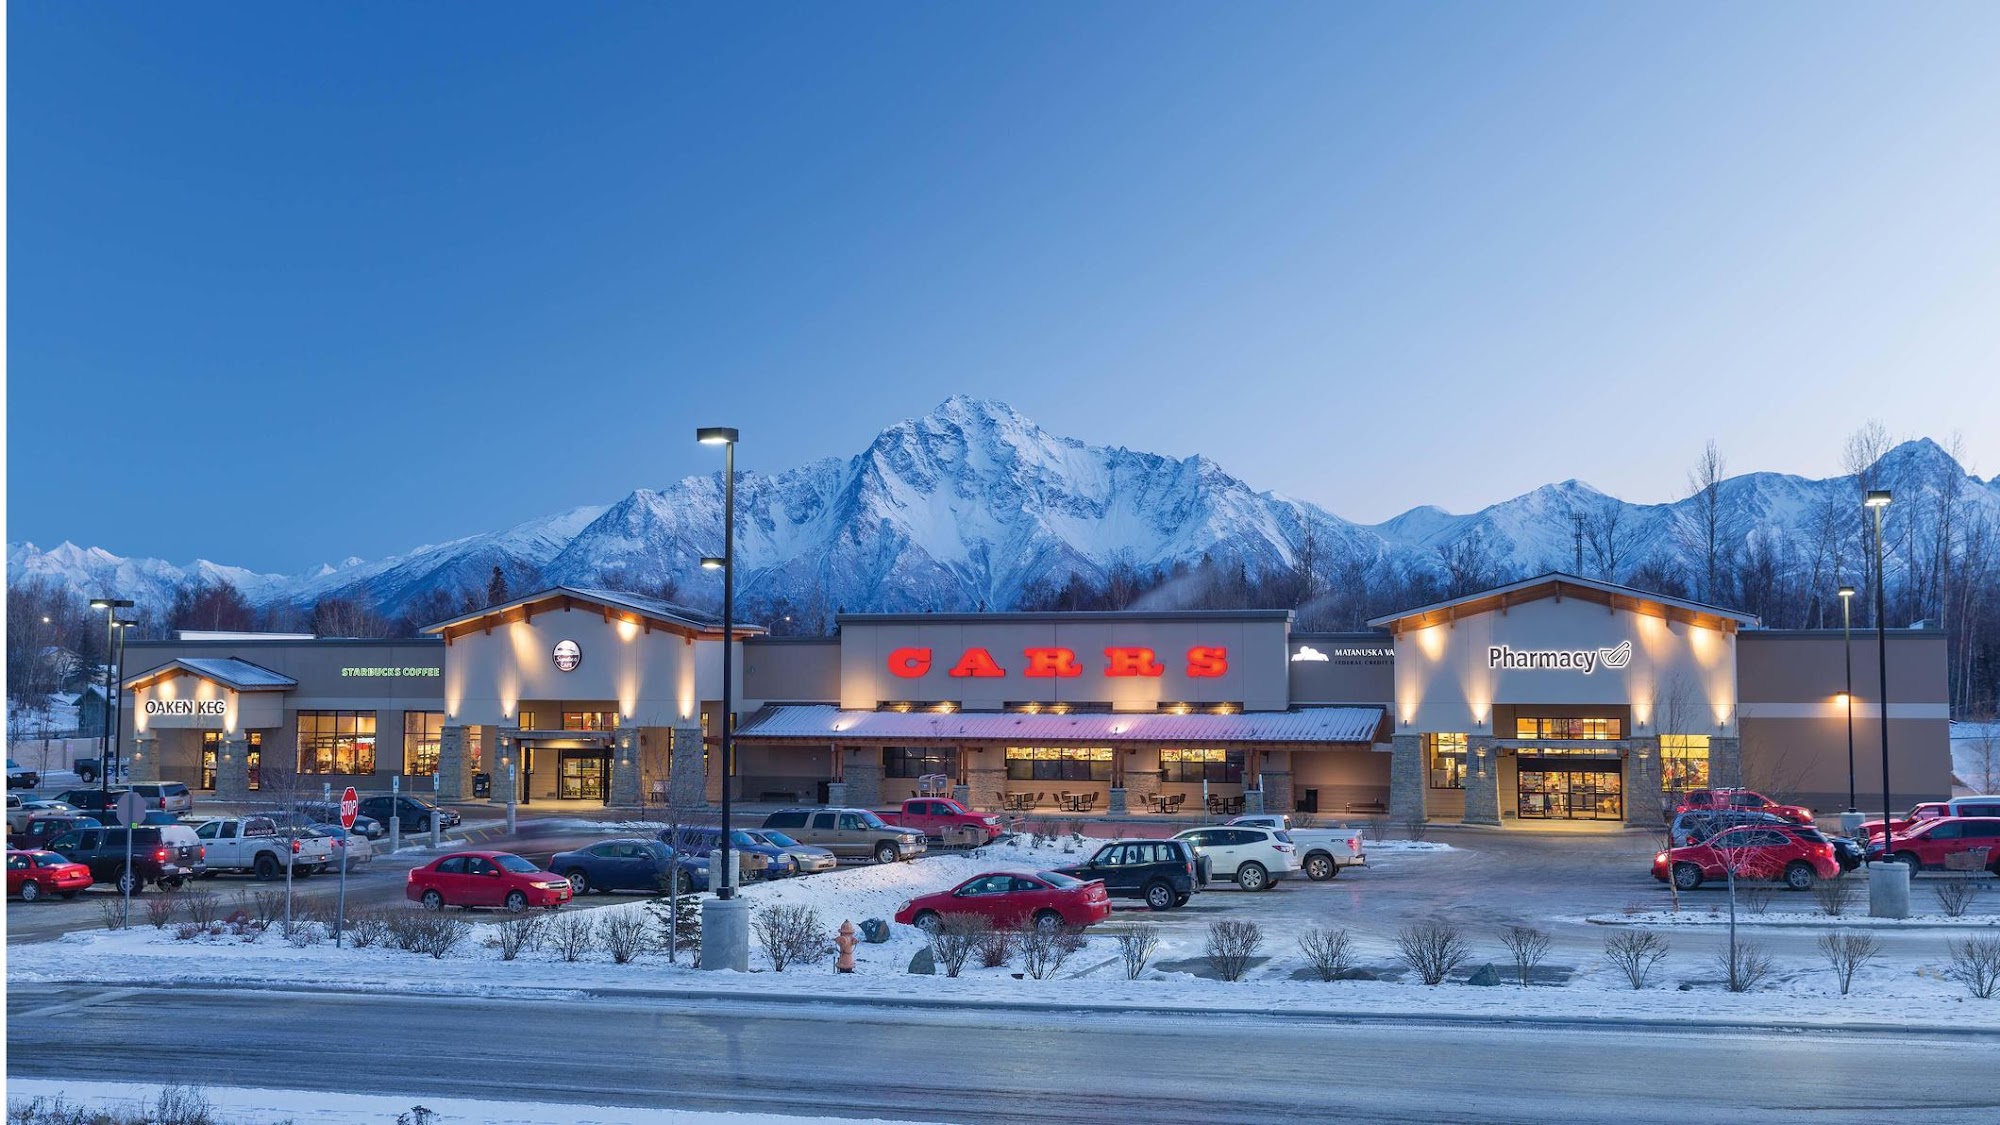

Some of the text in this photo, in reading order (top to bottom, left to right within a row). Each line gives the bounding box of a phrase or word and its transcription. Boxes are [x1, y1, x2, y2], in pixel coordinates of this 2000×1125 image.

[1334, 648, 1383, 657] MATANUSKA
[1489, 646, 1596, 673] Pharmacy
[887, 647, 1228, 678] CARRS
[341, 667, 440, 677] STARBUCKS COFFEE
[145, 700, 226, 714] OAKEN KEG
[342, 800, 357, 816] STOP
